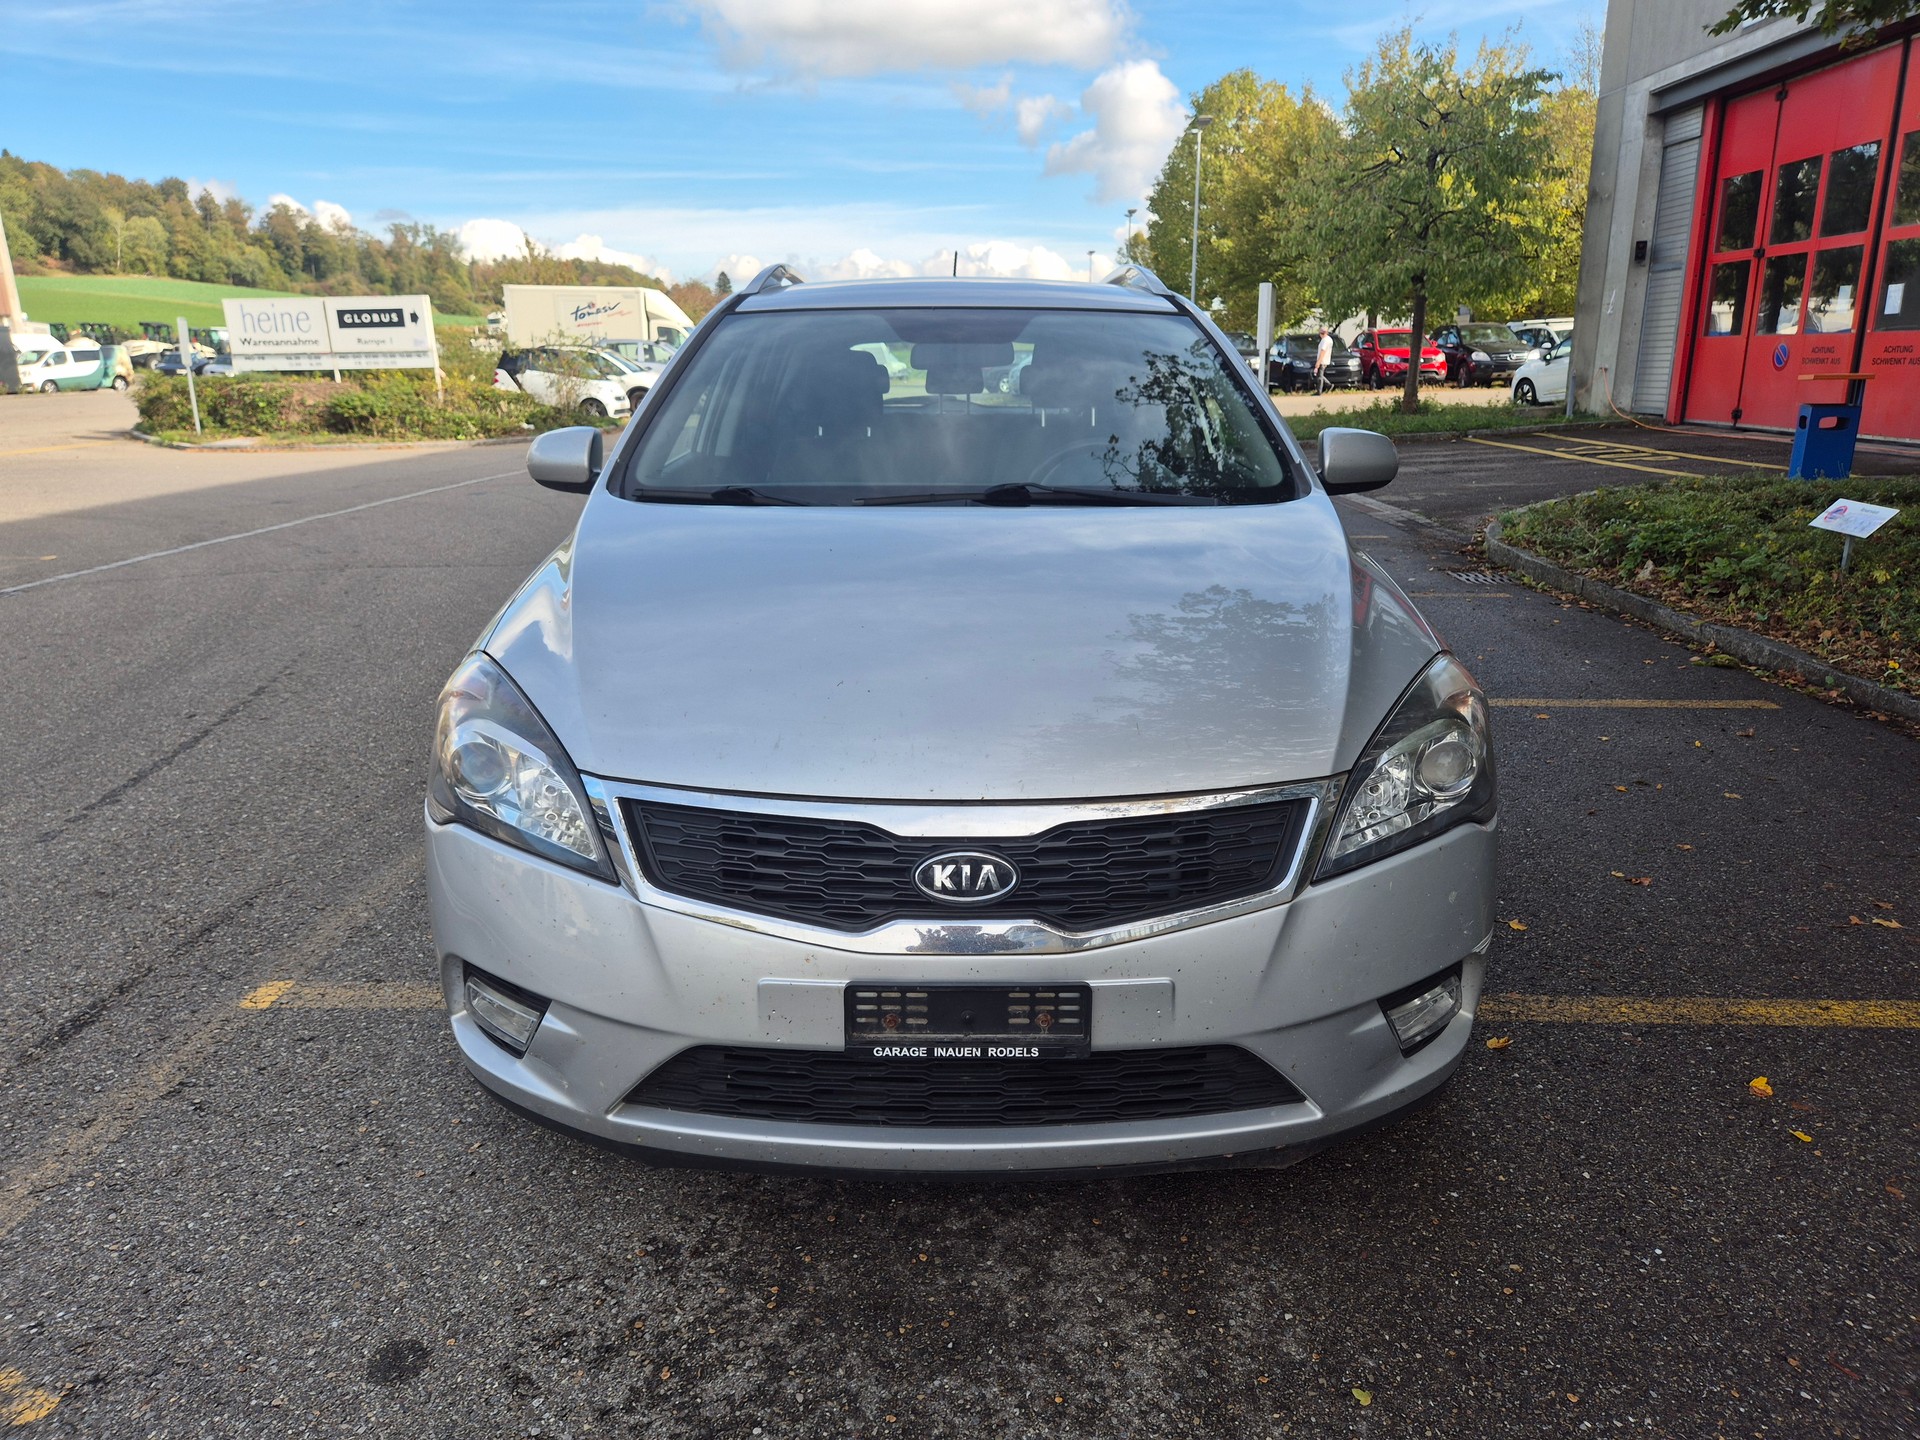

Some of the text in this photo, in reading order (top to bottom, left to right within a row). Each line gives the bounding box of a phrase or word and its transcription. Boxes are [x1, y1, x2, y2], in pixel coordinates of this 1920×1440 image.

[240, 303, 312, 334] heine
[343, 311, 399, 324] GLOBUS
[240, 337, 320, 347] Warenannahme
[356, 337, 386, 346] Rampe
[1811, 346, 1835, 354] ACHTUNG
[1883, 345, 1914, 354] ACHTUNG
[1801, 357, 1841, 365] SCHWENKT AUS
[1871, 357, 1920, 366] SCHWENKT AUS
[932, 864, 1001, 891] KIA
[873, 1047, 1039, 1058] GARAGE INAUEN RODELS
